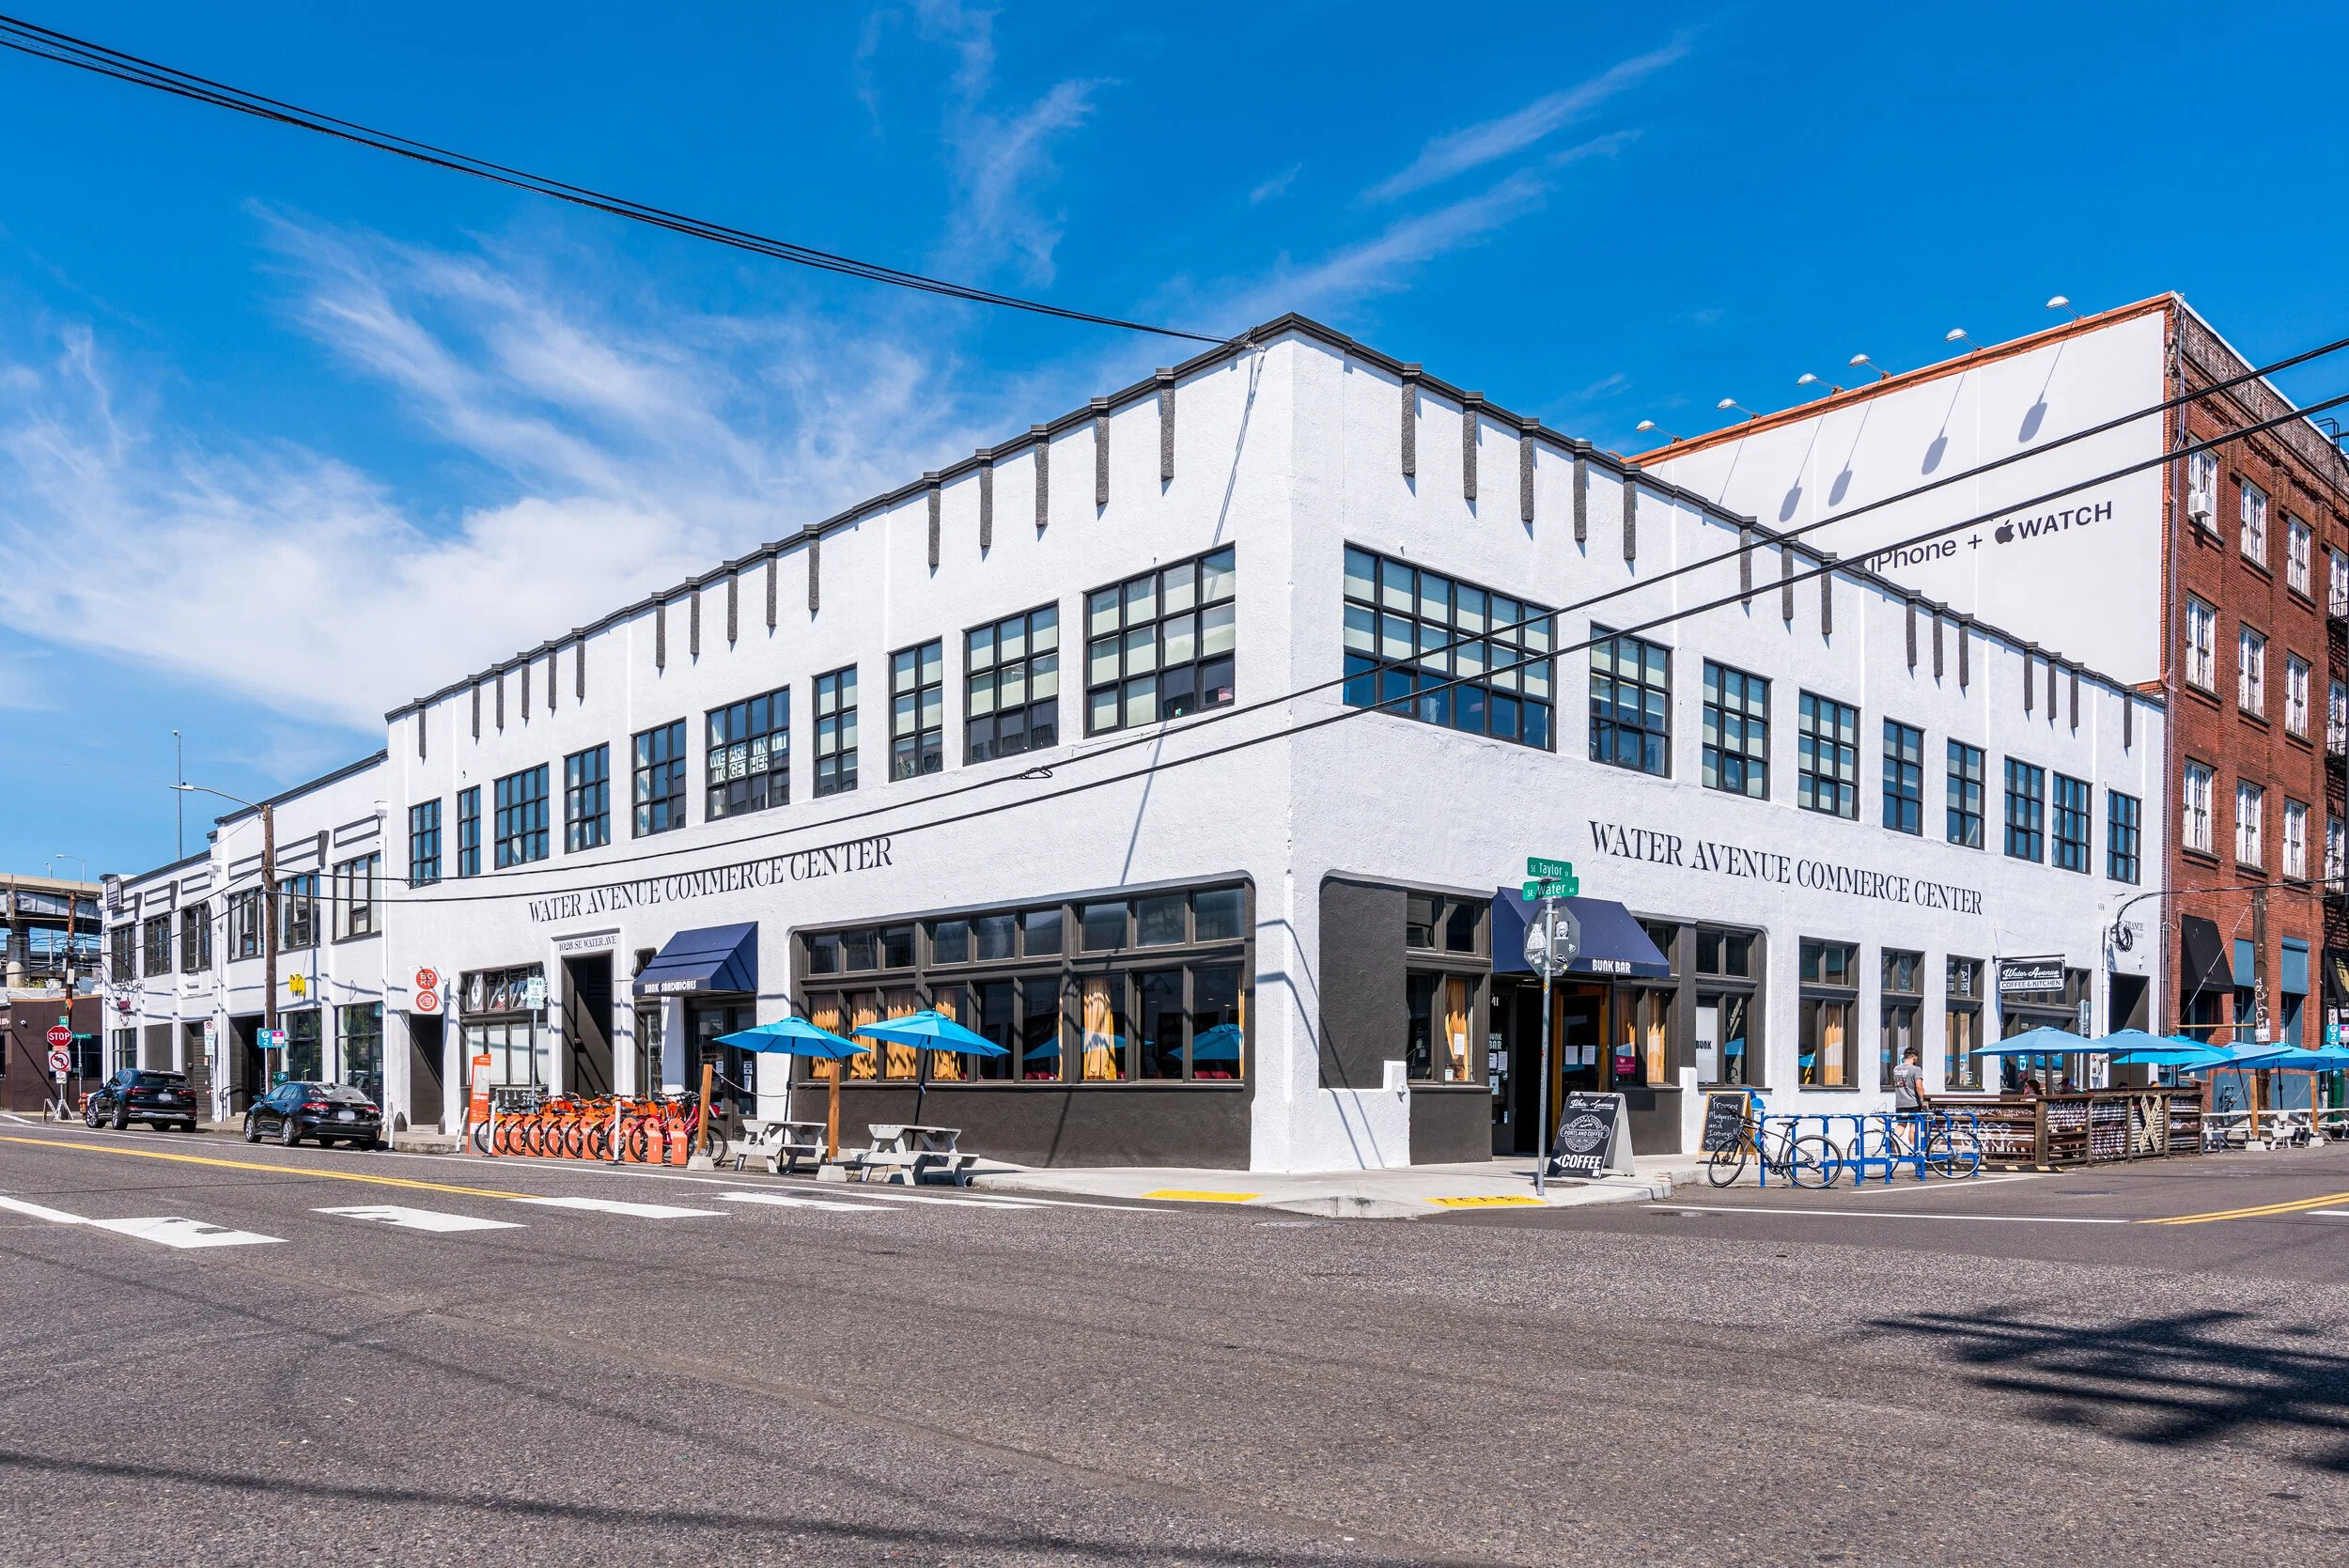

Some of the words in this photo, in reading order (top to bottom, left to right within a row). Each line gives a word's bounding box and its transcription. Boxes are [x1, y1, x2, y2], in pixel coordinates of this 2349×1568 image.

[2017, 501, 2112, 539] WATCH
[710, 749, 725, 768] WE
[730, 744, 746, 760] ARE
[754, 737, 768, 755] IN
[774, 734, 787, 751] IT
[1531, 864, 1536, 873] SE
[1539, 862, 1563, 877] Taylor
[1589, 819, 1683, 867] WATER
[1689, 839, 1791, 884] AVENUE
[1797, 859, 1909, 903] COMMERCE
[1914, 880, 1983, 915] CENTER
[528, 893, 582, 923] WATER
[586, 878, 661, 915] AVENUE
[665, 858, 784, 903] COMMERCE
[790, 836, 894, 881] CENTER
[1527, 889, 1533, 897] SE
[1538, 883, 1565, 895] Water
[559, 940, 573, 952] 1028
[574, 939, 583, 950] SE
[583, 938, 603, 948] WATER
[604, 935, 616, 946] AVE
[1592, 958, 1614, 972] BUNK
[1614, 960, 1631, 974] BAR
[2002, 967, 2028, 978] Water
[2028, 966, 2060, 979] Avenue
[645, 983, 660, 994] BUNK
[661, 979, 697, 992] SANDWICHES
[49, 1032, 70, 1041] STOP
[1696, 1040, 1712, 1050] BUNK
[1561, 1154, 1603, 1170] COFFEE
